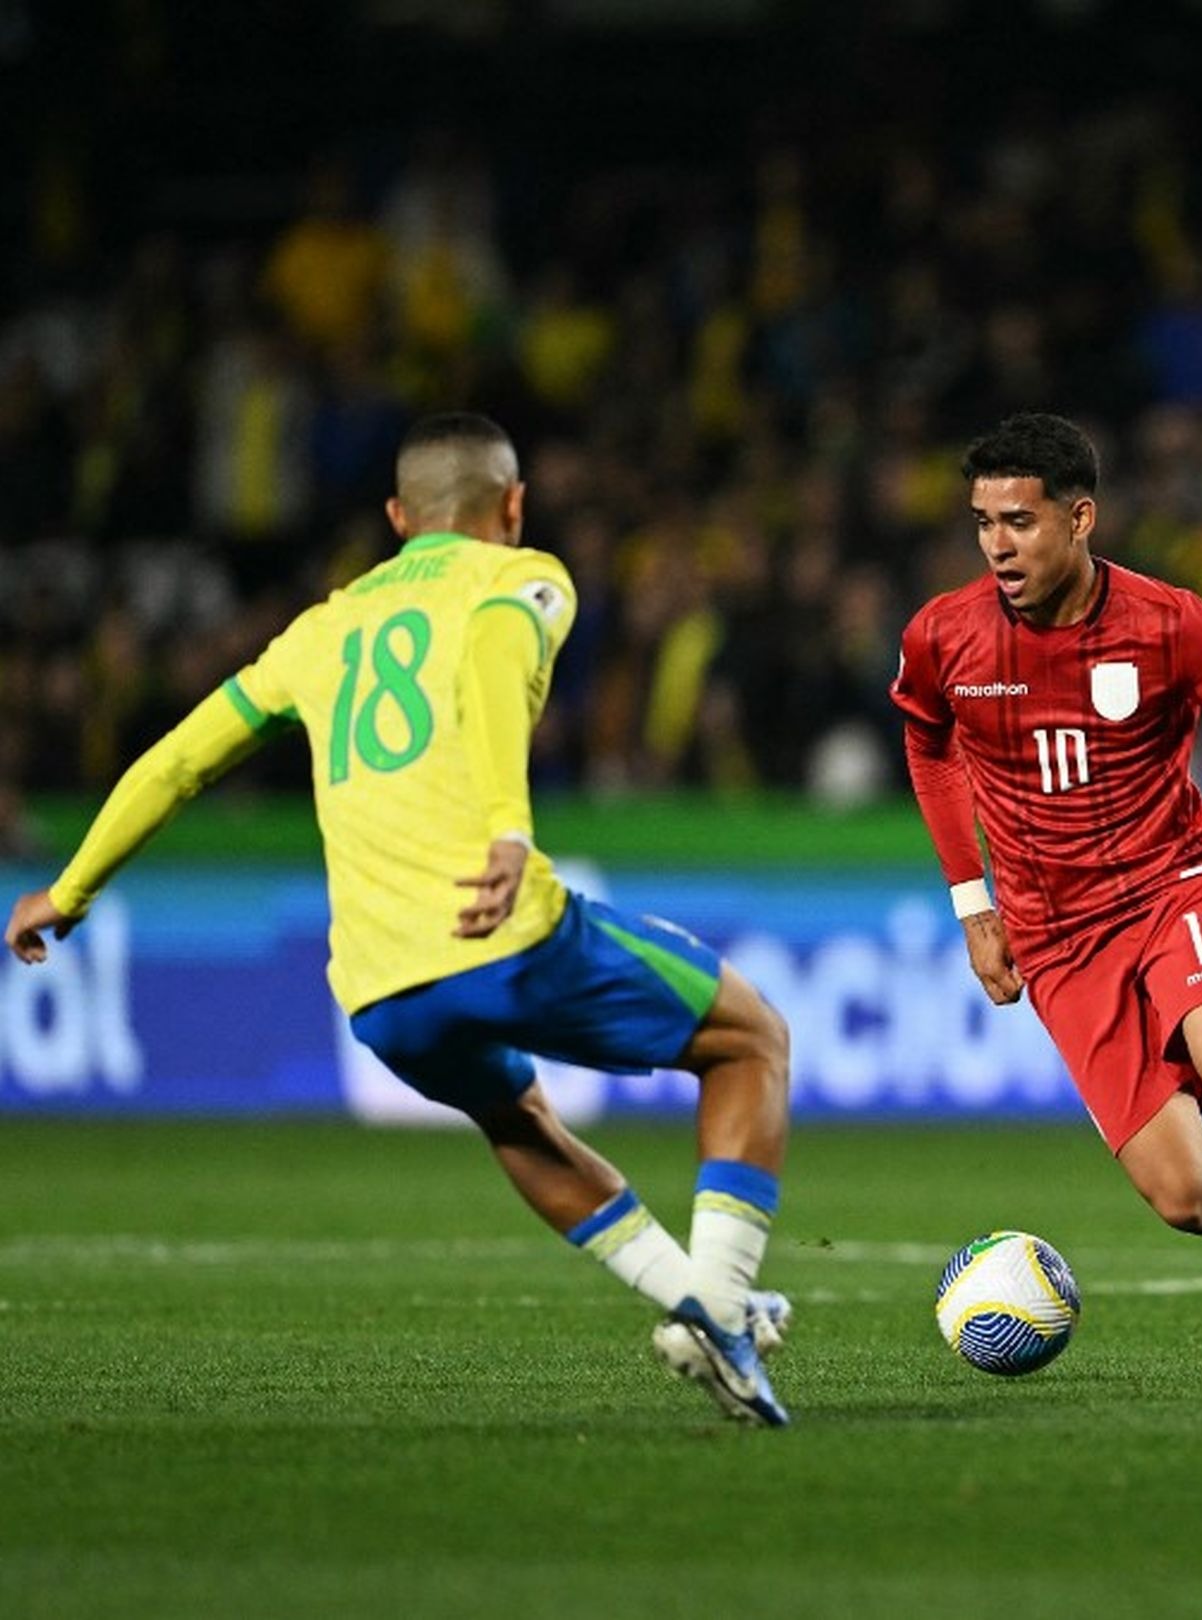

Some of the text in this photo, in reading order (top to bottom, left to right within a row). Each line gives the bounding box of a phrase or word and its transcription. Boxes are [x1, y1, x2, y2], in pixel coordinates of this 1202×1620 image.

[330, 608, 434, 785] 18
[954, 682, 1029, 697] marathon
[1033, 728, 1090, 794] 10
